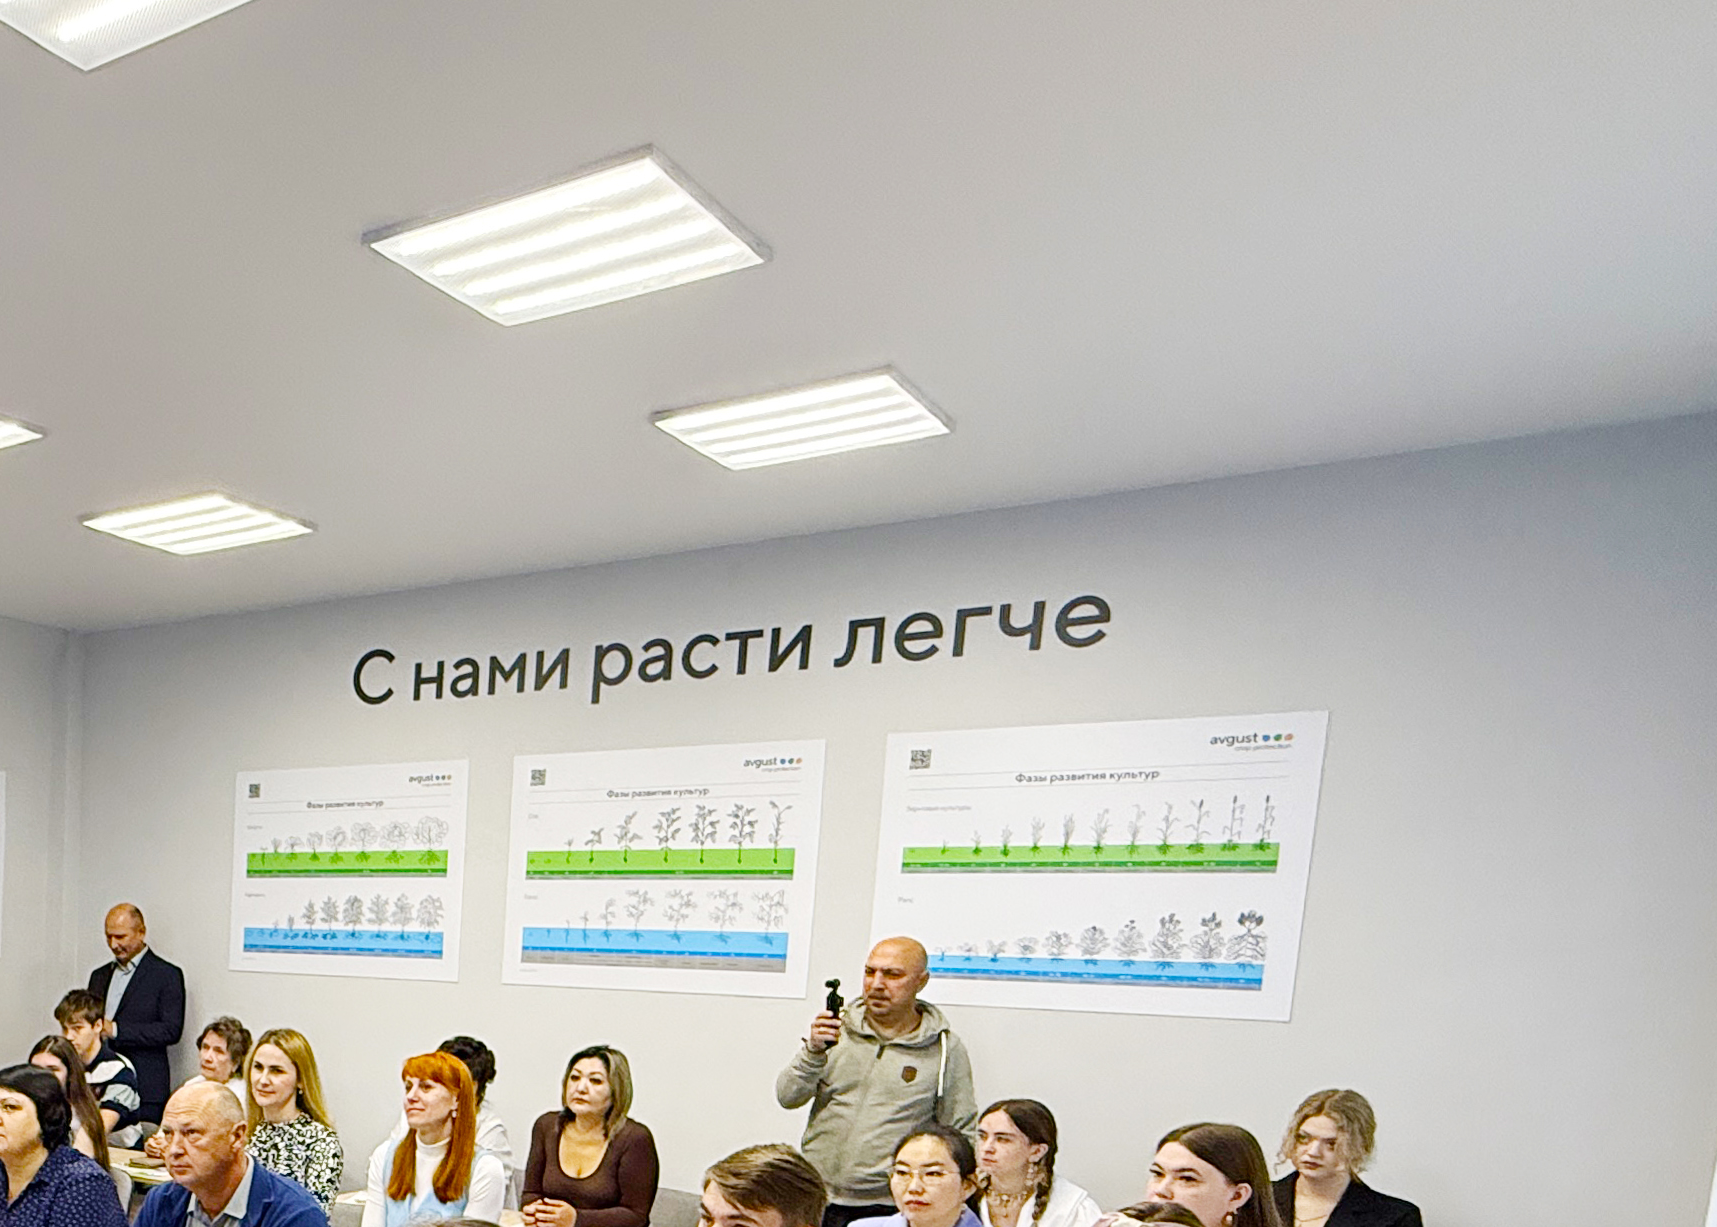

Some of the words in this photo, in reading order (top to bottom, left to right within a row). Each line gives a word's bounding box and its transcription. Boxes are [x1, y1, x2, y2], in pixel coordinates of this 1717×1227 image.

[354, 649, 395, 704] С
[414, 648, 570, 700] нами
[592, 625, 812, 704] расти
[834, 596, 1110, 667] легче
[1210, 733, 1258, 746] avgust
[744, 757, 777, 769] avgust
[408, 774, 434, 784] avgust
[1015, 773, 1047, 783] Фазы
[1050, 771, 1107, 785] развития
[1109, 770, 1160, 784] культур
[606, 789, 630, 799] Фазы
[632, 789, 672, 799] развития
[673, 787, 710, 798] культур
